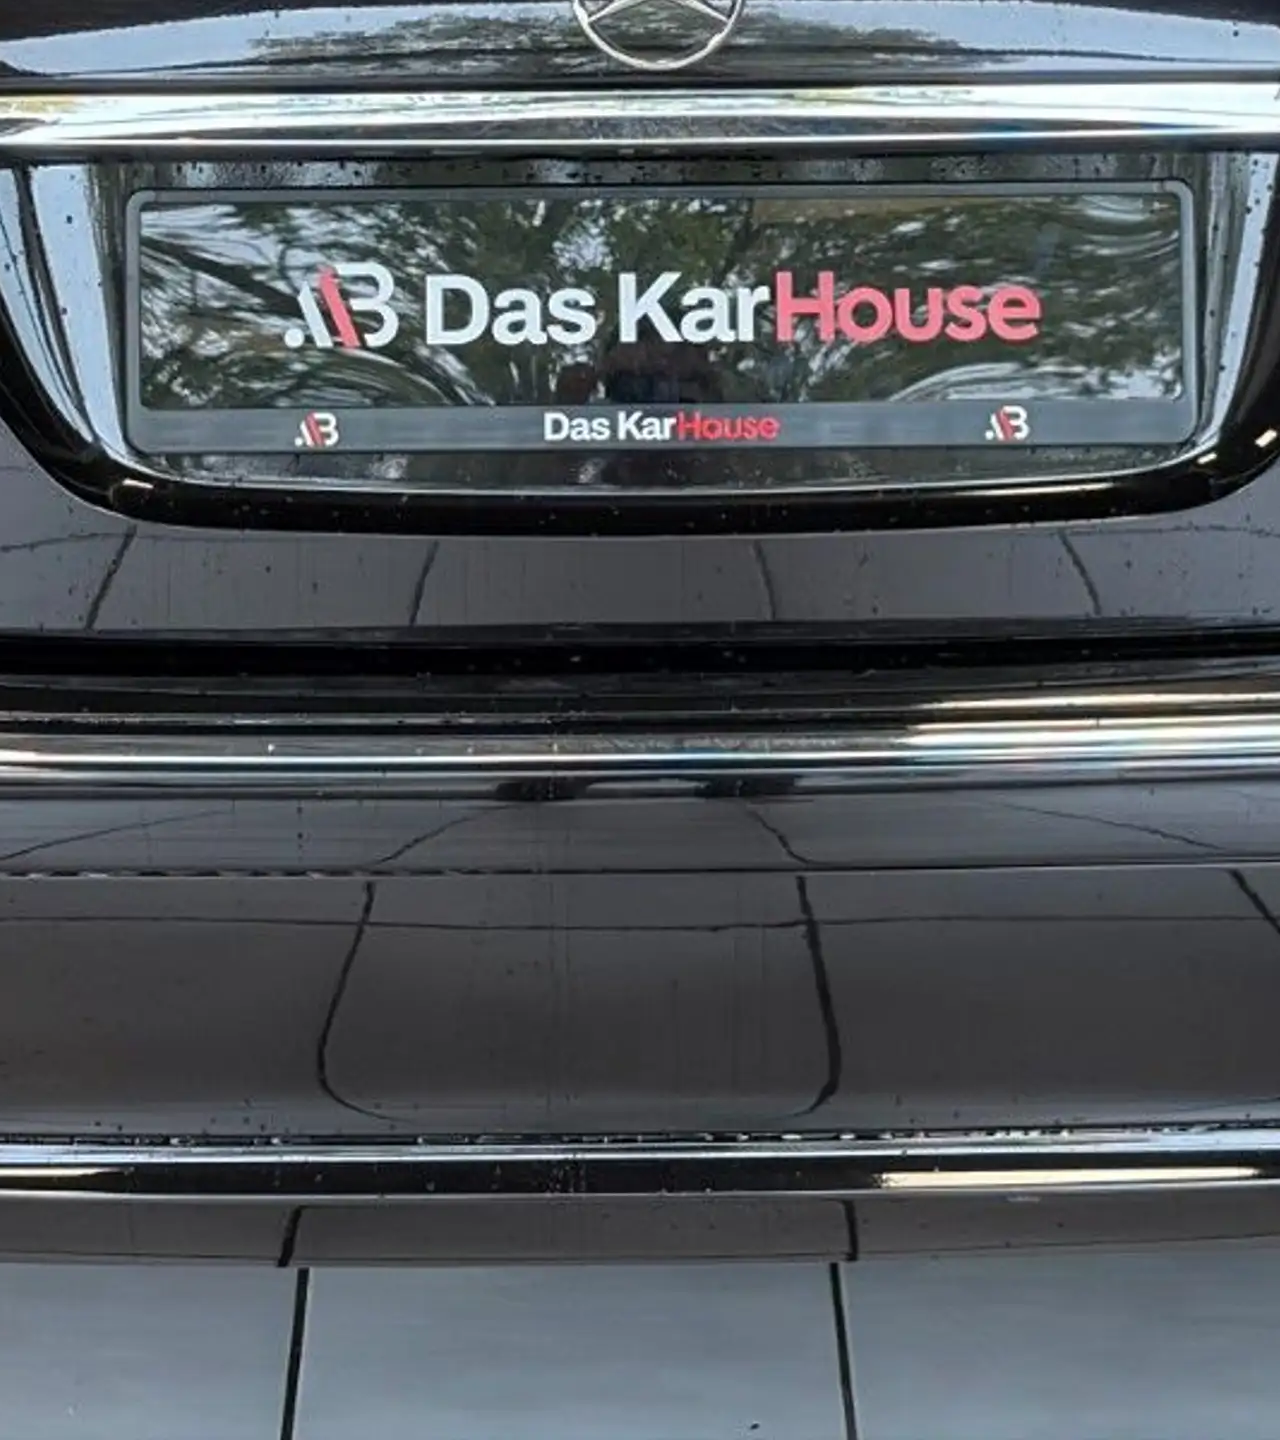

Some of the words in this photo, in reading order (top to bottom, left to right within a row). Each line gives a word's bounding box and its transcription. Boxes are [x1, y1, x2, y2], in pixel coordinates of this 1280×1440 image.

[426, 274, 596, 346] Das
[620, 270, 1042, 343] KarHouse
[543, 412, 610, 441] Das
[618, 411, 781, 440] KarHouse
